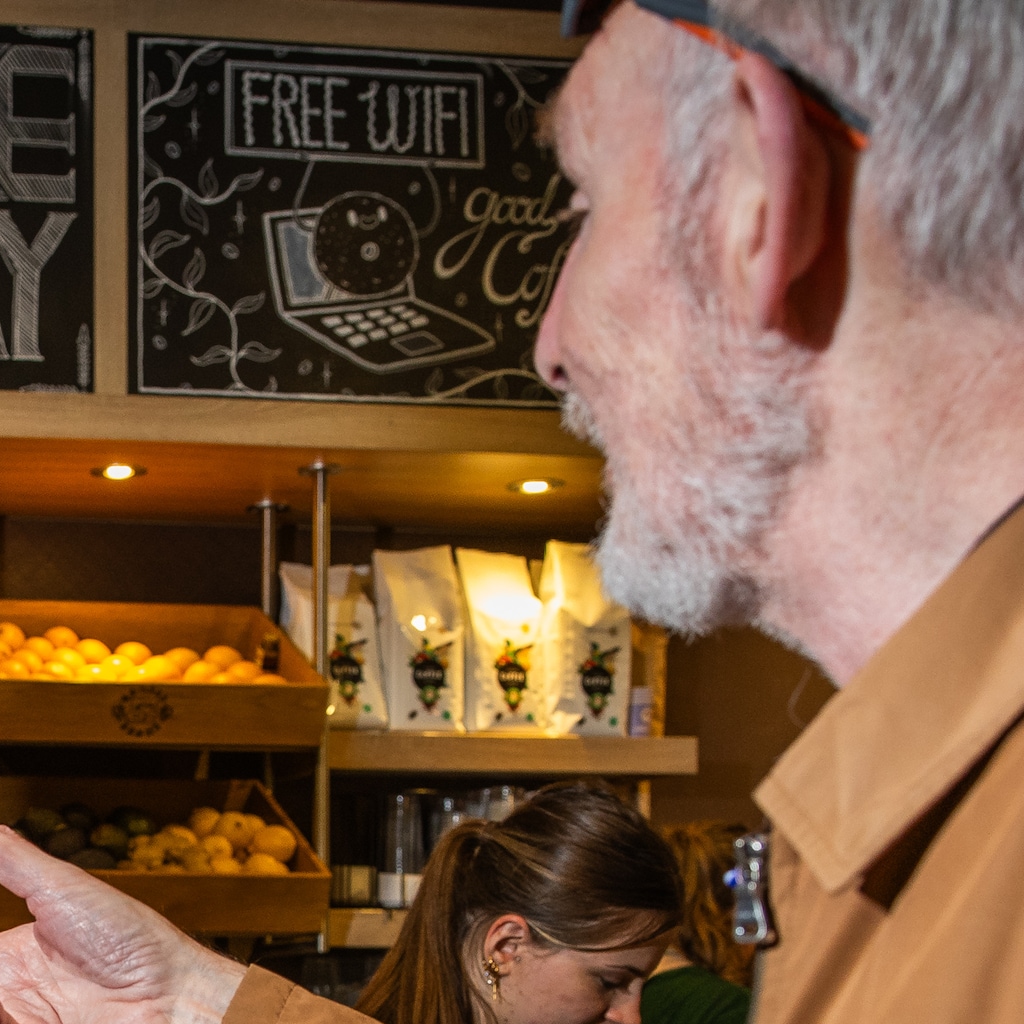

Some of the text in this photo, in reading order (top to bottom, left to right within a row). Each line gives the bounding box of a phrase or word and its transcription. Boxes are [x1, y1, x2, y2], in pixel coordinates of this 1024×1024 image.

[241, 71, 470, 157] FREE WIFI
[433, 172, 562, 279] good
